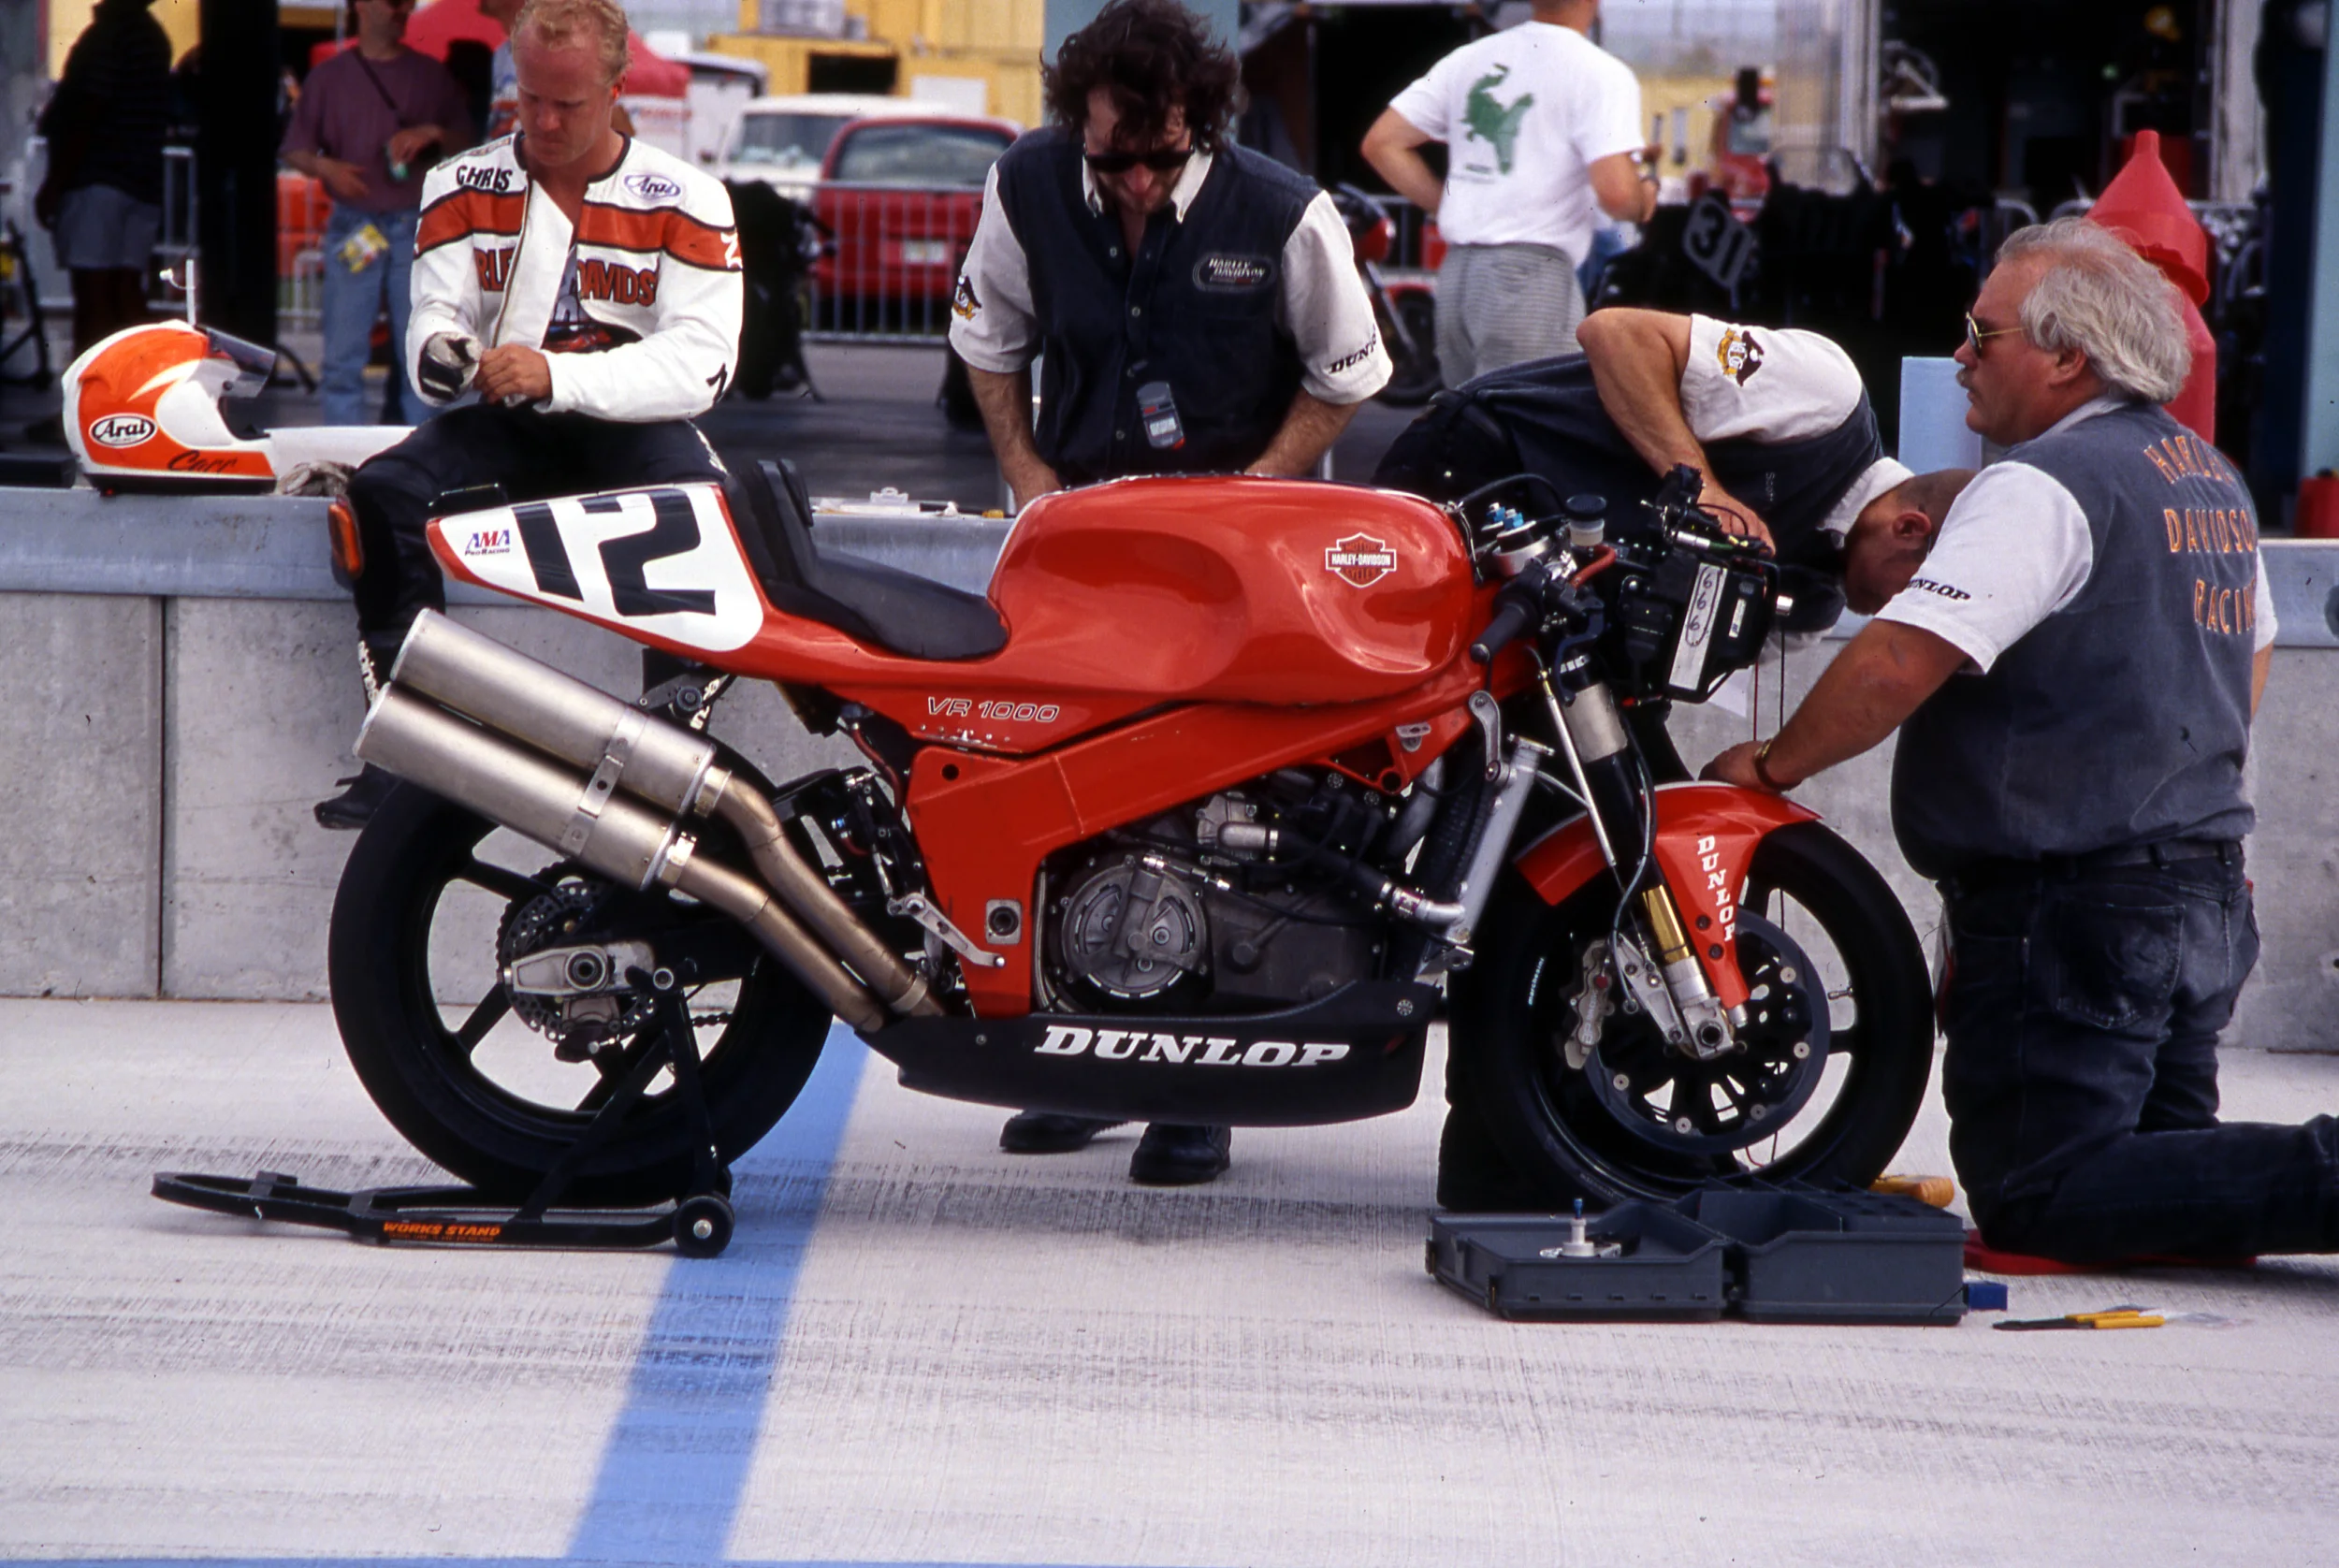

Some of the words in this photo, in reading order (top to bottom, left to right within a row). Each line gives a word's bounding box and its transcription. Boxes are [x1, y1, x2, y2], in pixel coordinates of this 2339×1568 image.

[456, 166, 514, 193] CHRIS
[1689, 203, 1745, 281] 31
[1213, 267, 1266, 278] DAVIDSON
[97, 418, 148, 441] Arai
[167, 449, 239, 473] Carr
[466, 529, 511, 550] AMA
[511, 487, 717, 617] 12
[1331, 553, 1391, 566] HARLEY-DAVIDSON
[927, 696, 972, 718] VR
[978, 700, 1060, 723] 1000
[1697, 834, 1736, 942] DUNLOP
[1033, 1024, 1351, 1067] DUNLOP
[383, 1221, 443, 1235] WORKS
[444, 1224, 501, 1237] STAND
